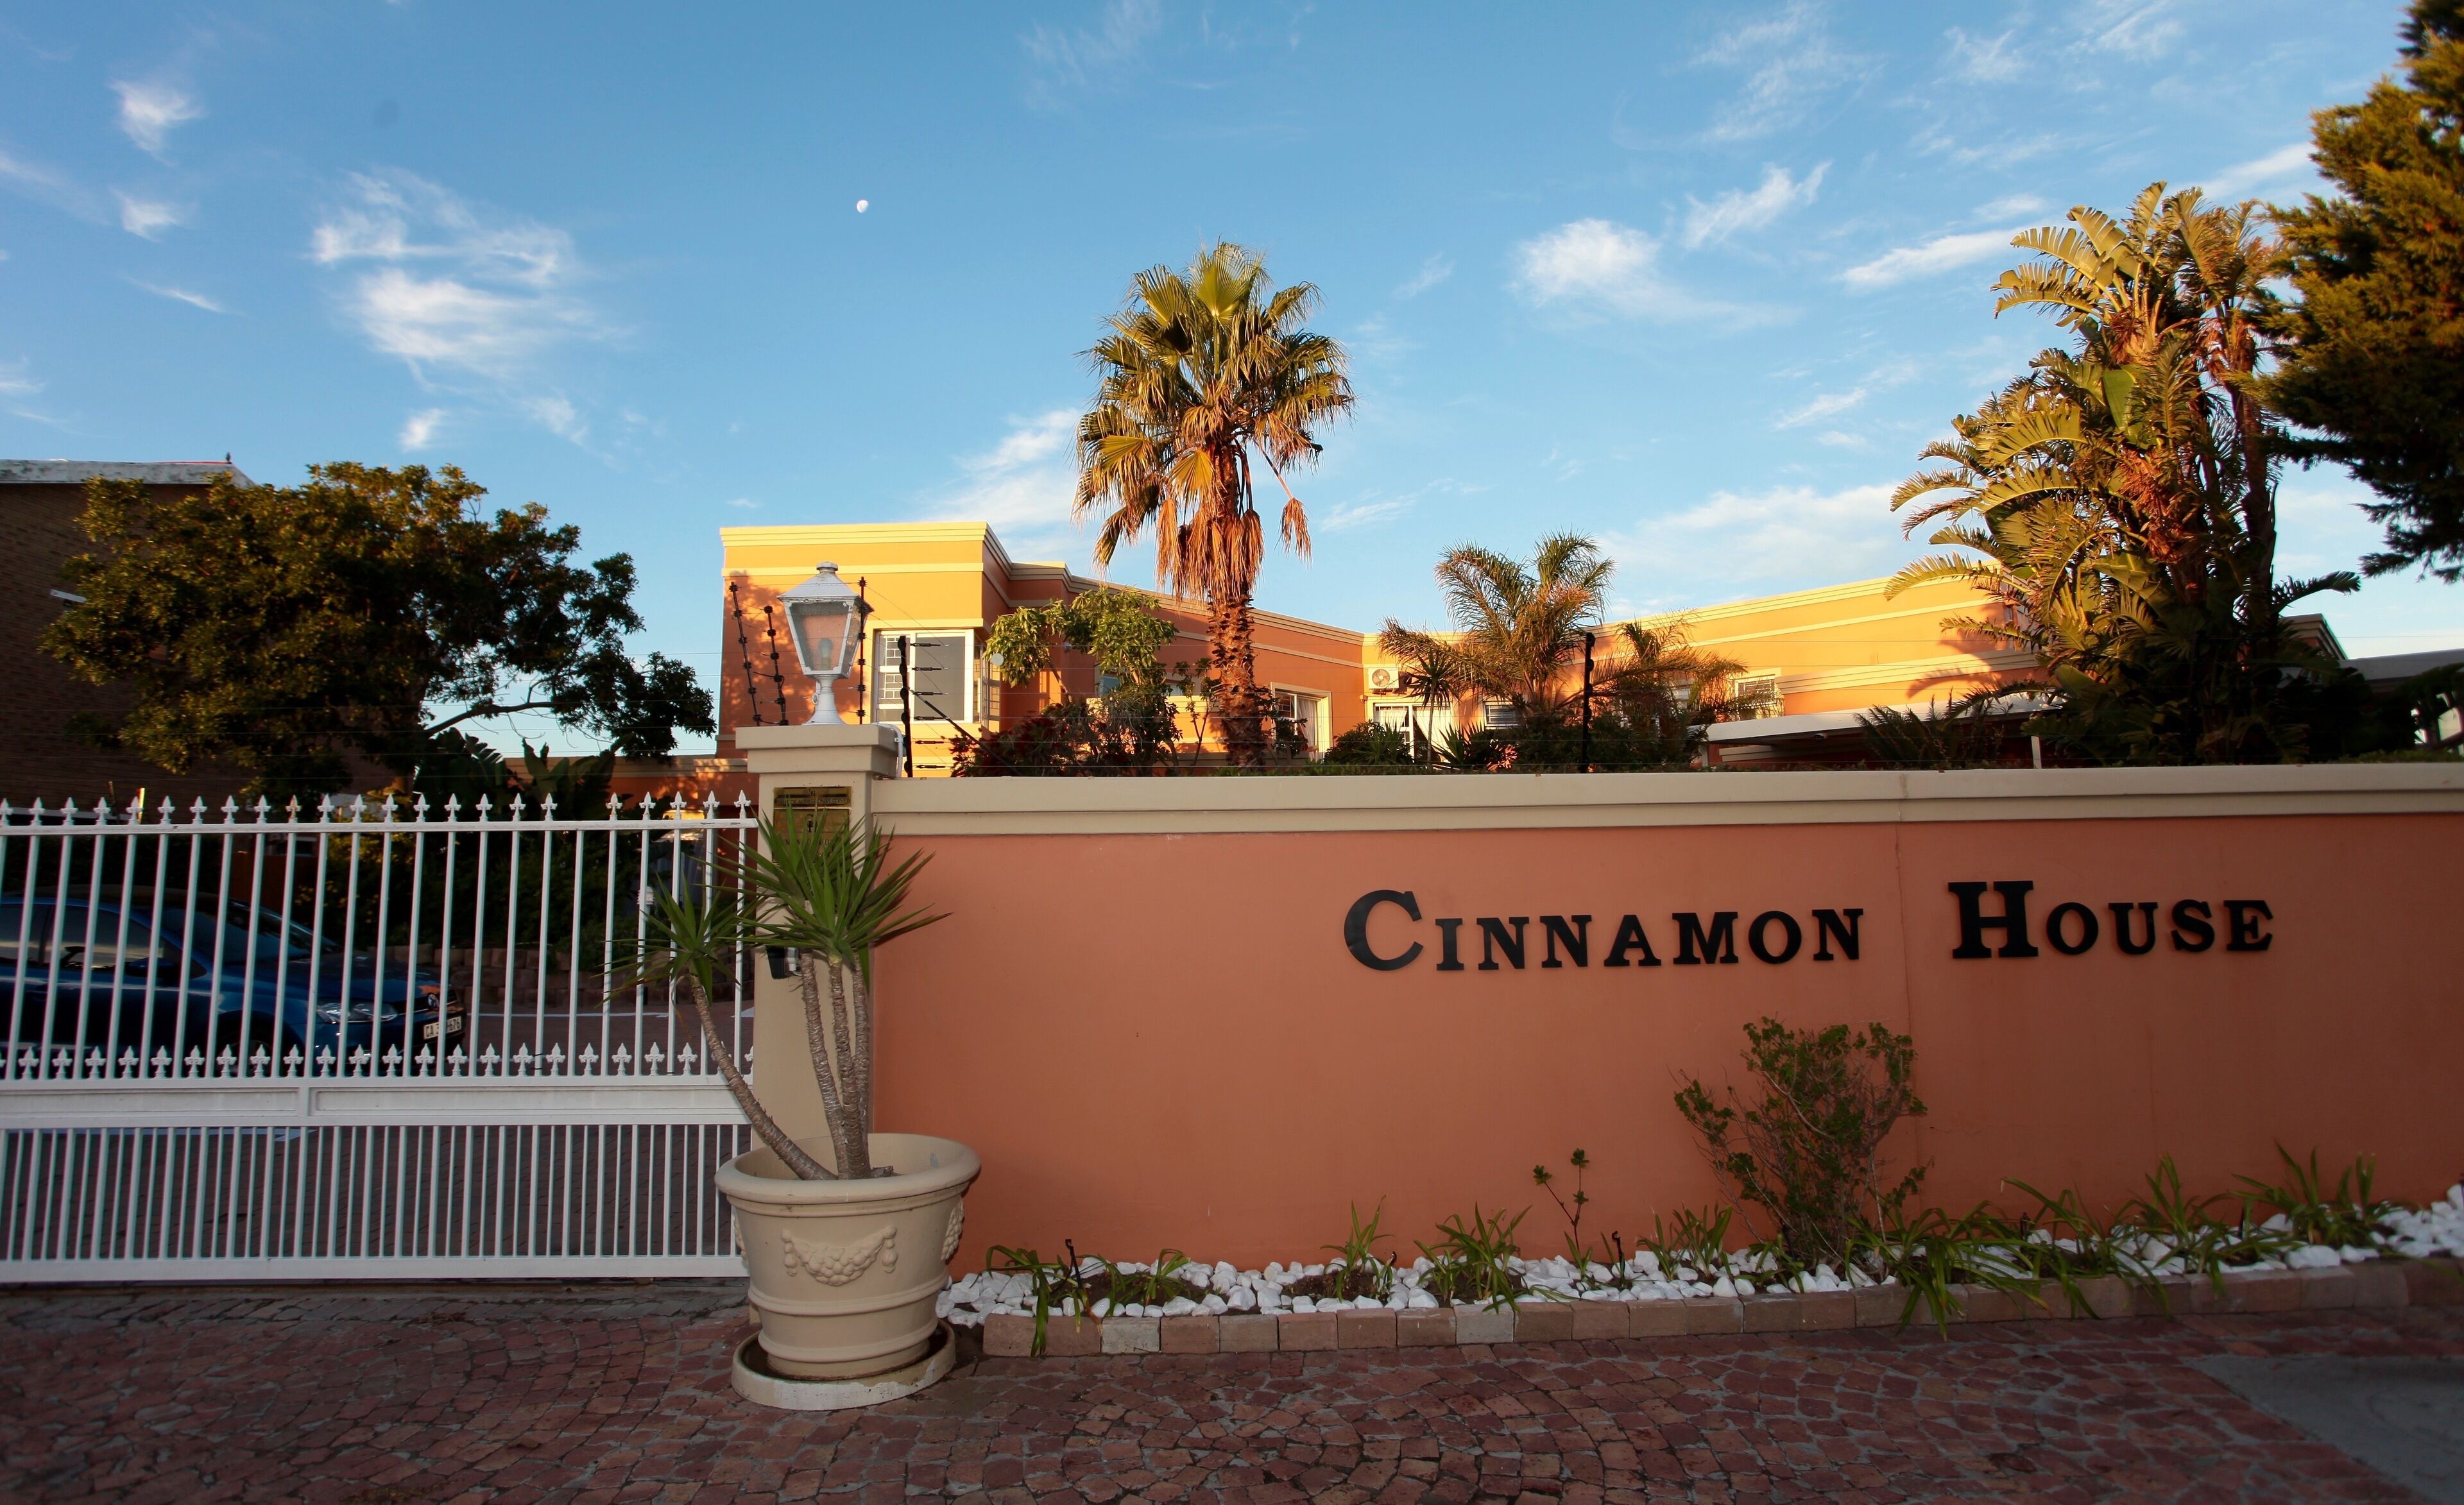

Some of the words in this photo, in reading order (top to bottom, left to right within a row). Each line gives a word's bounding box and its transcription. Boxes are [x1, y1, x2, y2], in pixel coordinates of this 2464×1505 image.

[1344, 890, 1864, 971] CINNAMON
[1947, 880, 2273, 959] HOUSE
[426, 1025, 434, 1037] CA
